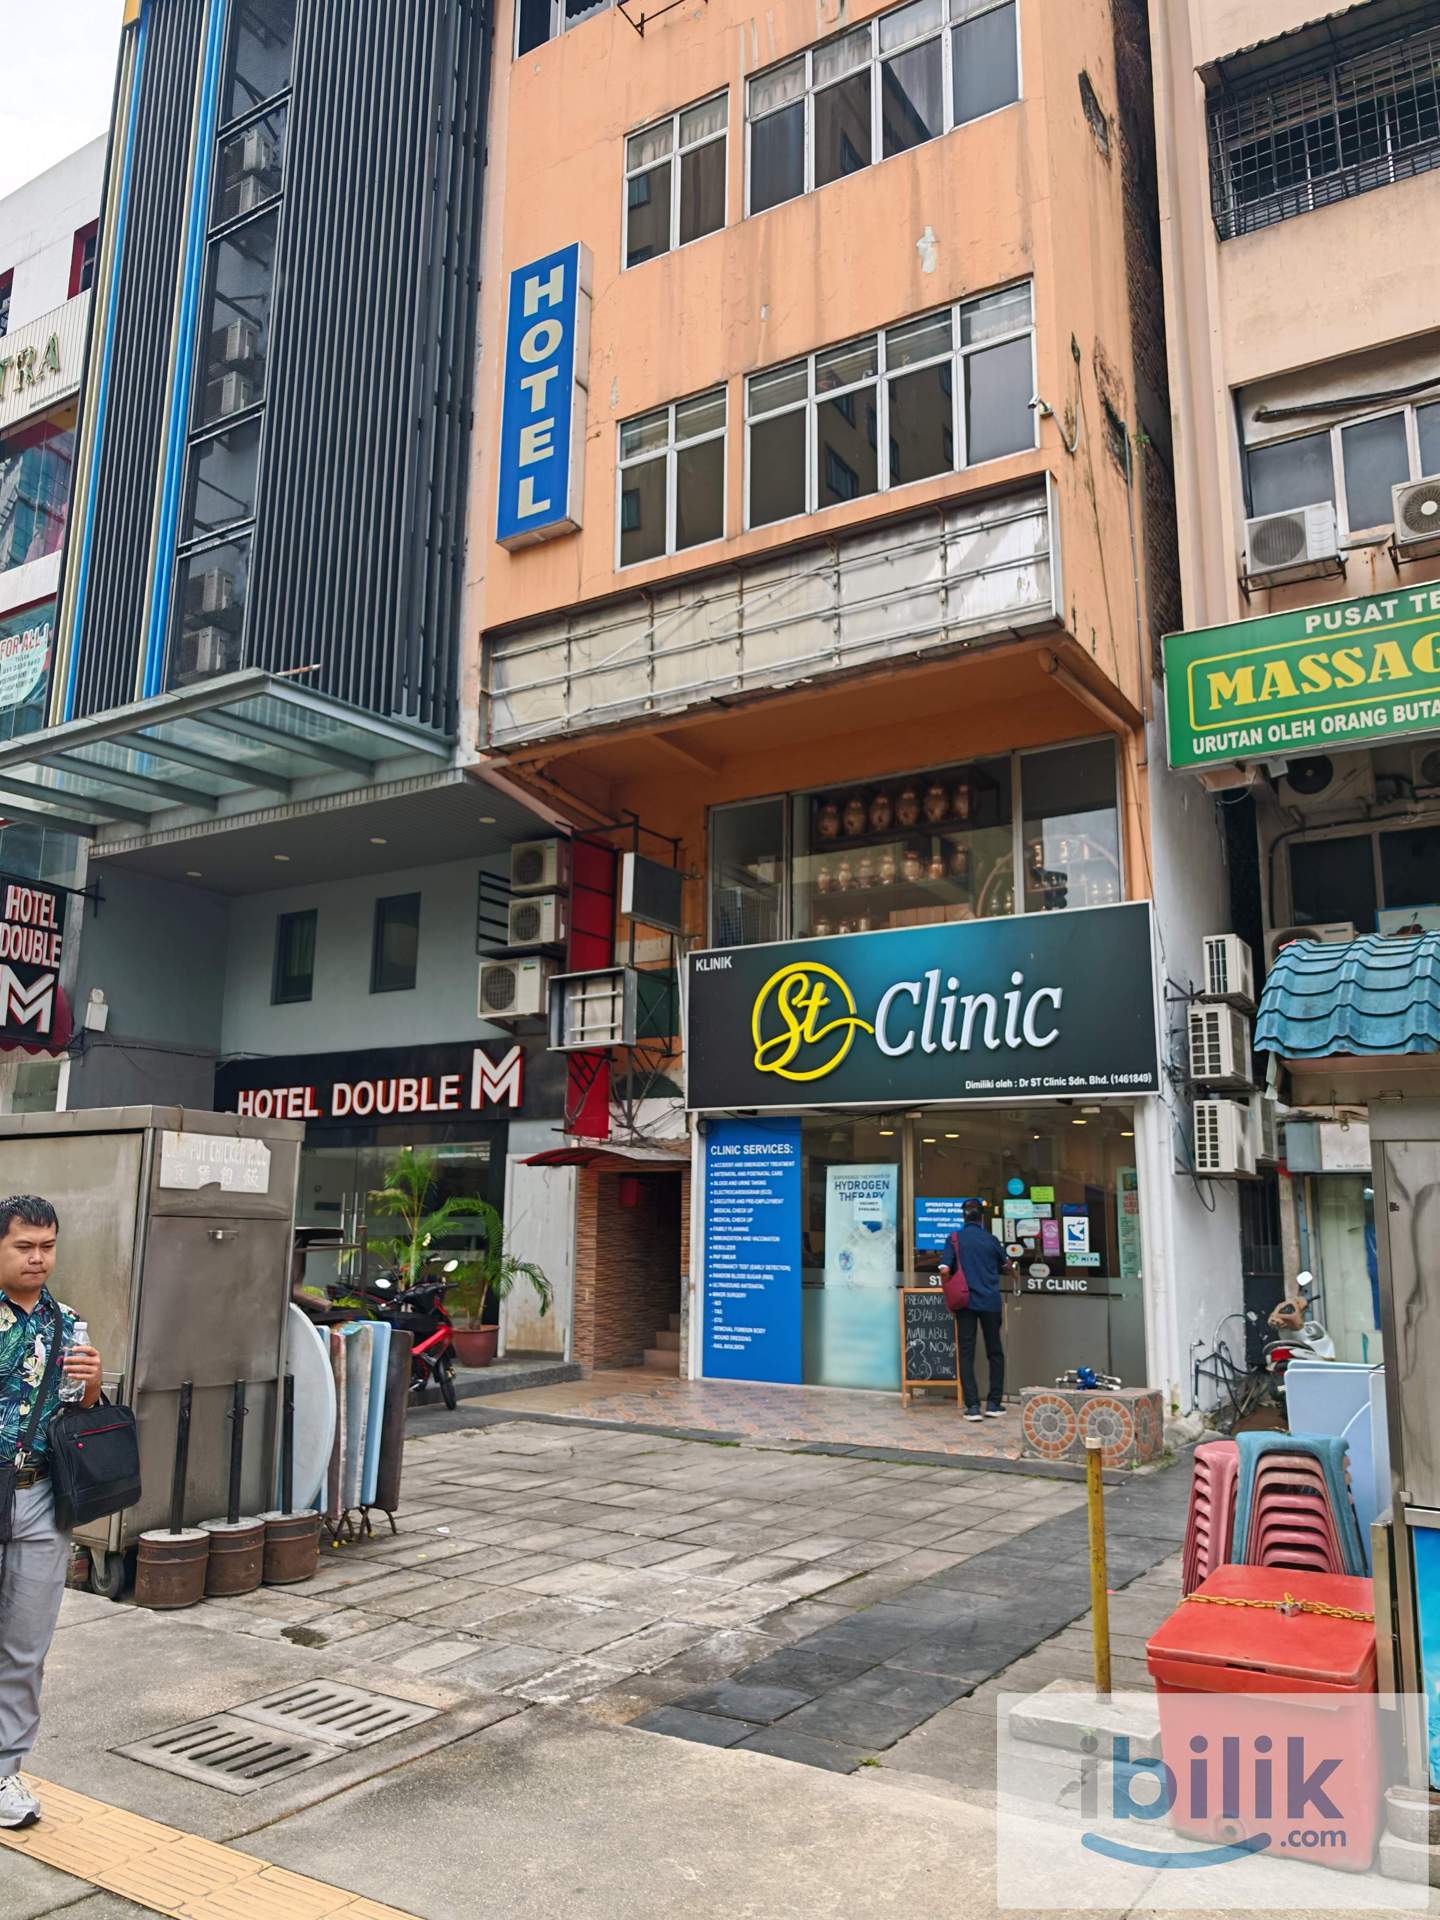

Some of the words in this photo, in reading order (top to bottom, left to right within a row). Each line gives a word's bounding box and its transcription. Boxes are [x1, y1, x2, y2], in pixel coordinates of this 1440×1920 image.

[517, 263, 565, 520] HOTEL
[1305, 599, 1399, 634] PUSAT
[1192, 727, 1263, 755] URUTAN
[1268, 718, 1316, 742] OLEH
[1321, 707, 1388, 734] ORANG
[4, 884, 59, 930] HOTEL
[0, 921, 63, 969] DOUBLE
[695, 955, 733, 972] KLINIK
[0, 963, 55, 1034] M
[875, 968, 1063, 1057] Clinic
[237, 1086, 322, 1119] HOTEL
[331, 1074, 463, 1117] DOUBLE
[470, 1045, 525, 1110] M
[965, 1079, 994, 1090] Dimiliki
[995, 1078, 1013, 1089] oleh
[1019, 1077, 1029, 1088] Dr
[1030, 1077, 1042, 1088] ST
[1043, 1076, 1067, 1087] Clinic
[1068, 1075, 1088, 1086] Sdn.
[1089, 1074, 1109, 1085] Bhd.
[710, 1145, 741, 1156] CLINIC
[743, 1143, 794, 1155] SERVICES:
[834, 1180, 890, 1191] HYDROGEN
[838, 1191, 885, 1202] THERAPY
[1027, 1278, 1043, 1290] ST
[1046, 1279, 1088, 1291] CLINIC
[906, 1327, 948, 1340] AVAILABLE
